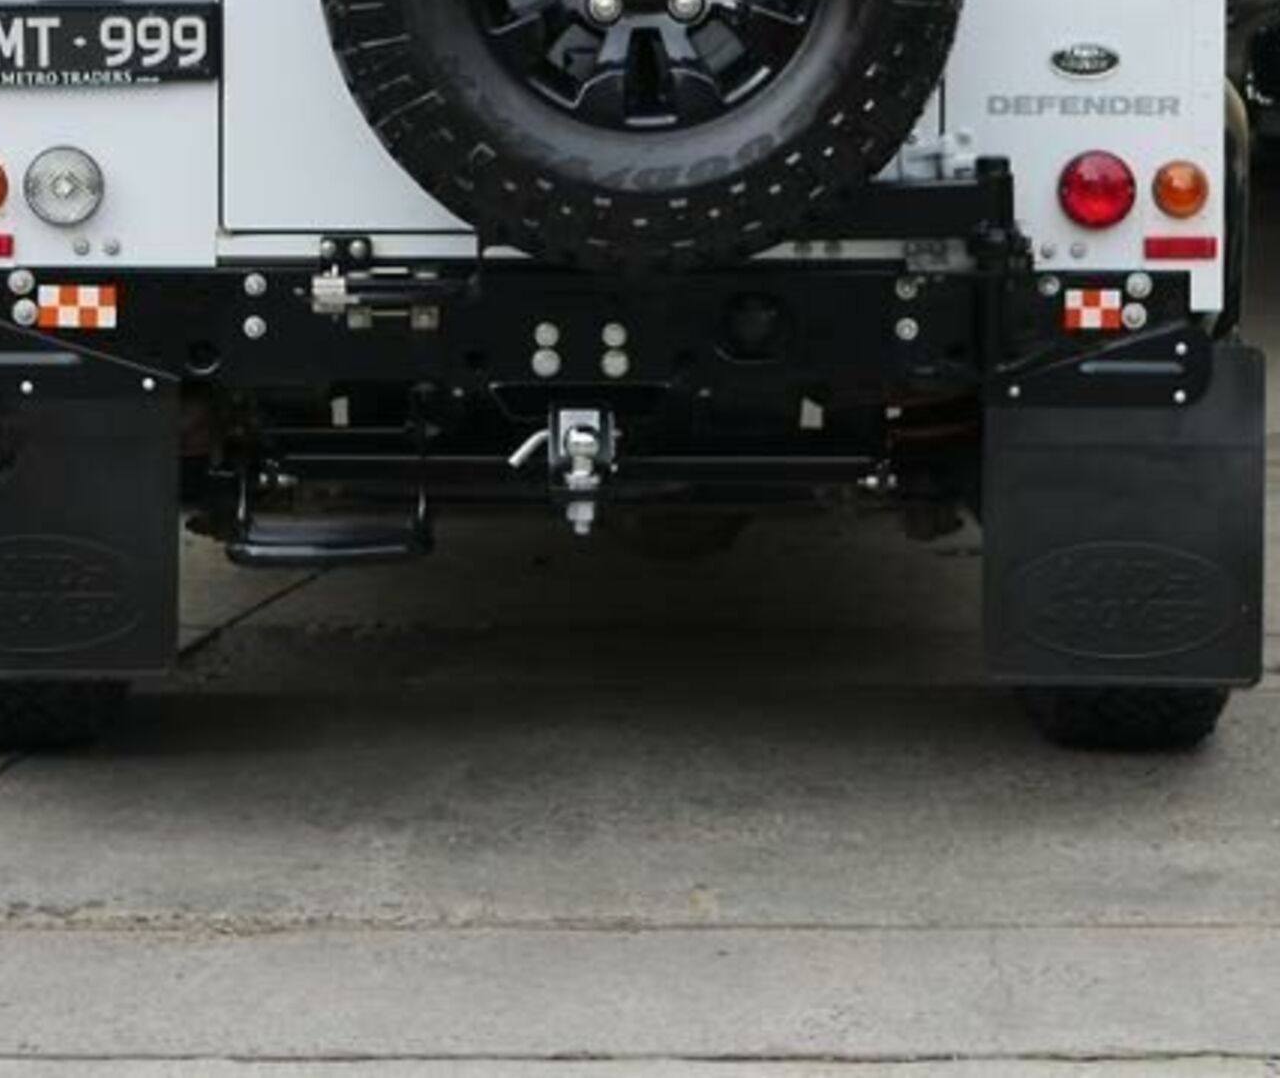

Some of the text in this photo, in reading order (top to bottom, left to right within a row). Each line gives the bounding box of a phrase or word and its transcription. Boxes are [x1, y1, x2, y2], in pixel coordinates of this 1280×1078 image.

[99, 15, 208, 68] 999
[0, 71, 58, 85] METRO
[61, 70, 133, 84] TRADERS
[987, 95, 1181, 116] DEFENDER
